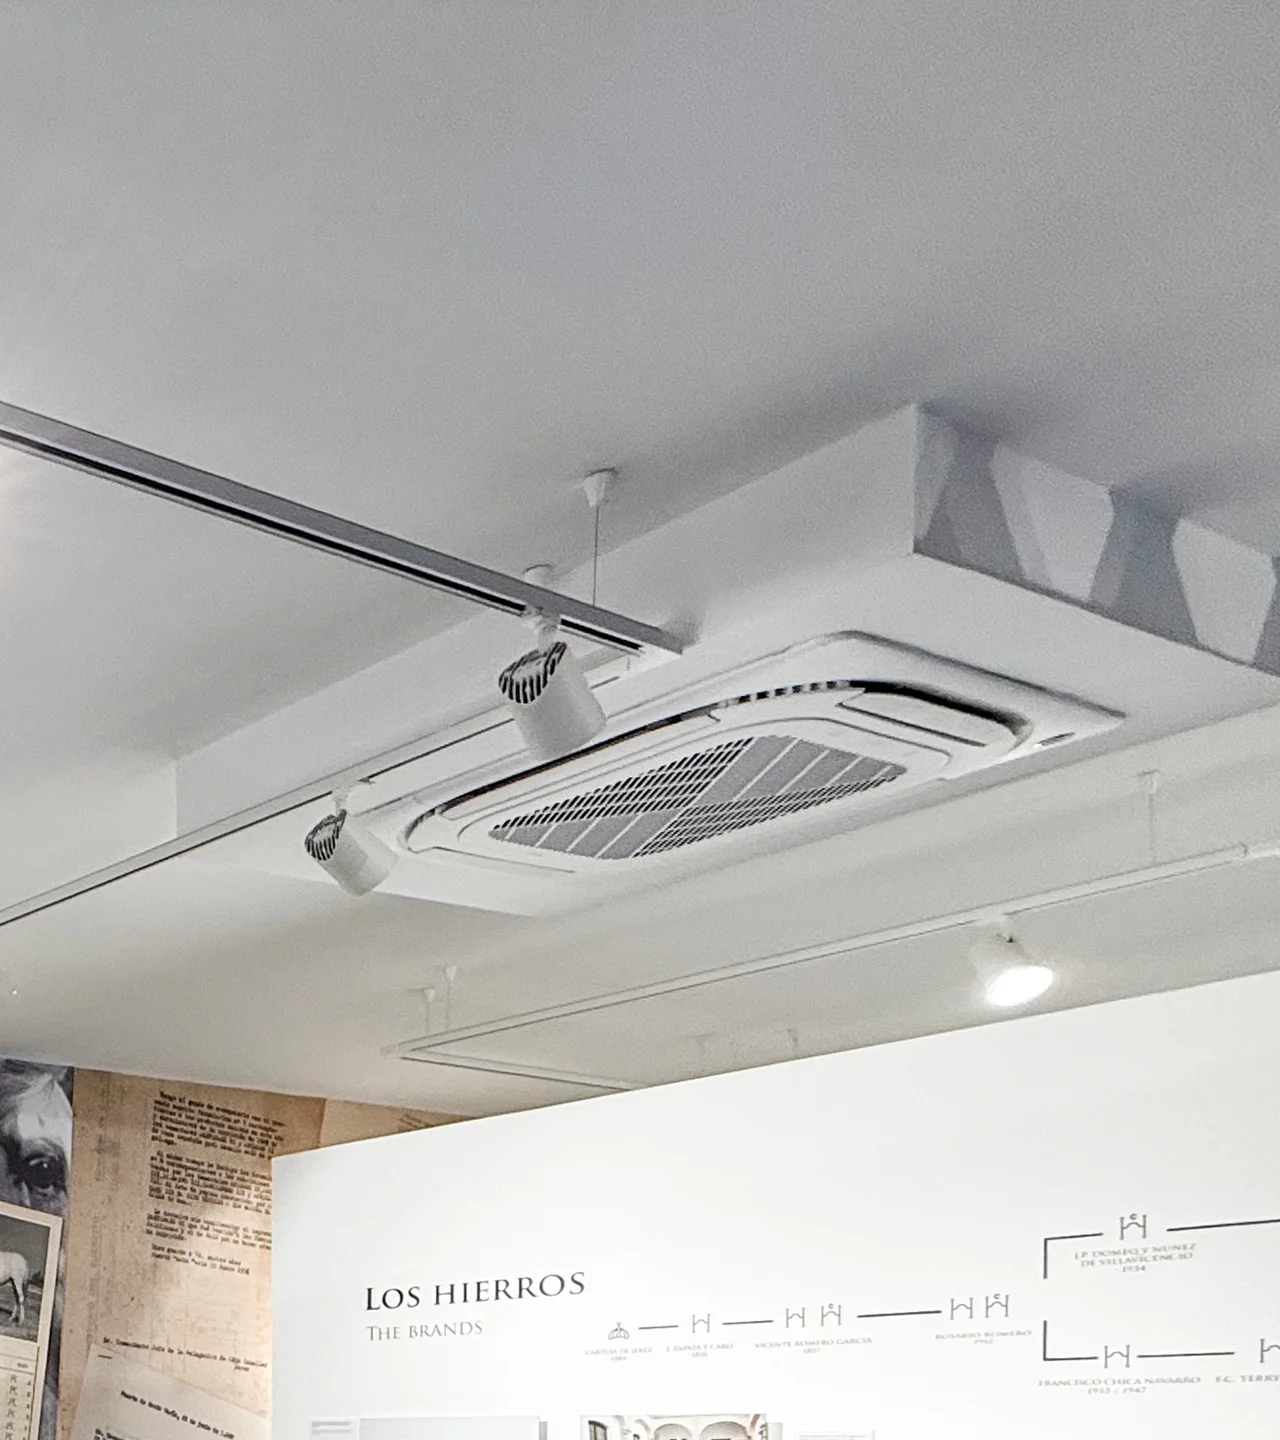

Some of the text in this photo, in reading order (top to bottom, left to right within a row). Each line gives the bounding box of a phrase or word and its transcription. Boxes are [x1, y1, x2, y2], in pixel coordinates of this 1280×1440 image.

[366, 1272, 585, 1311] LOS HIERROS
[366, 1321, 483, 1341] THE BRANDS
